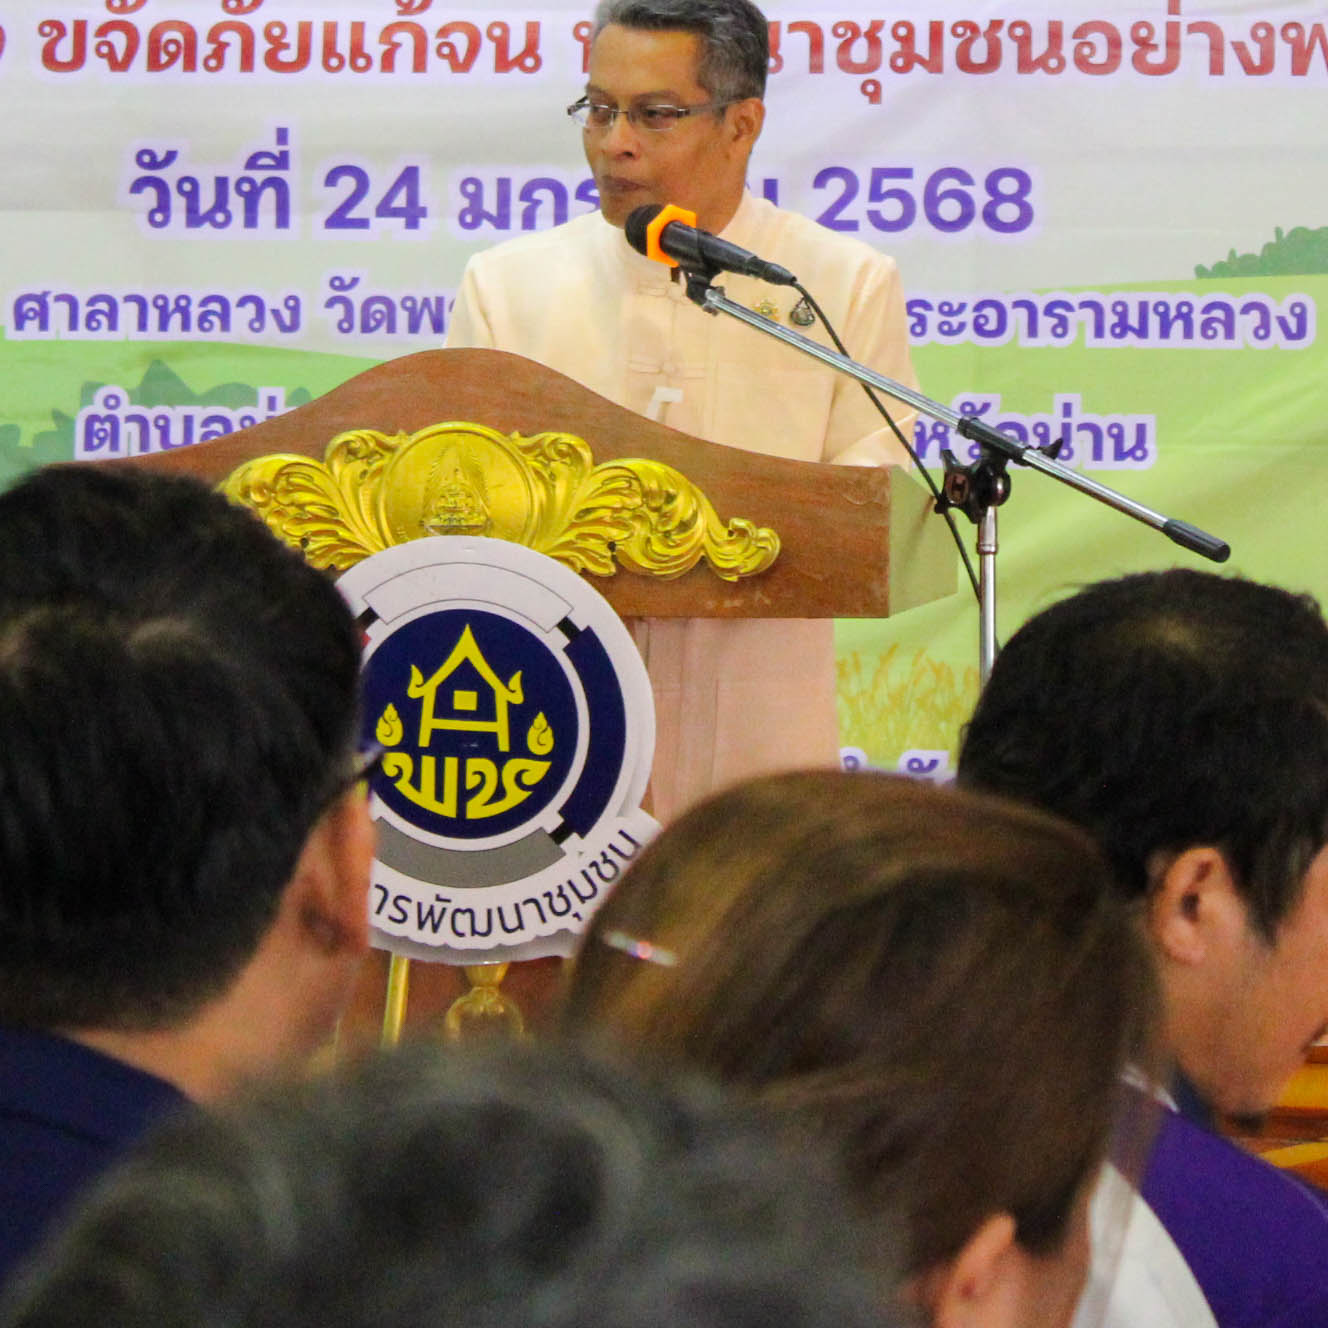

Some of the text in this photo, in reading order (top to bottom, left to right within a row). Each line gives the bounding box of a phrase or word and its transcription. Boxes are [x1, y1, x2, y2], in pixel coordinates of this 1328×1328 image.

[128, 126, 292, 231] วันที่
[323, 164, 429, 231] 24
[812, 165, 1035, 234] 2568
[12, 288, 303, 334] ศาลาหลวง
[323, 275, 457, 336] วัดพ
[905, 297, 1310, 342] ระอารามหลวง
[373, 827, 645, 939] ารพัฒนาชุมชน
